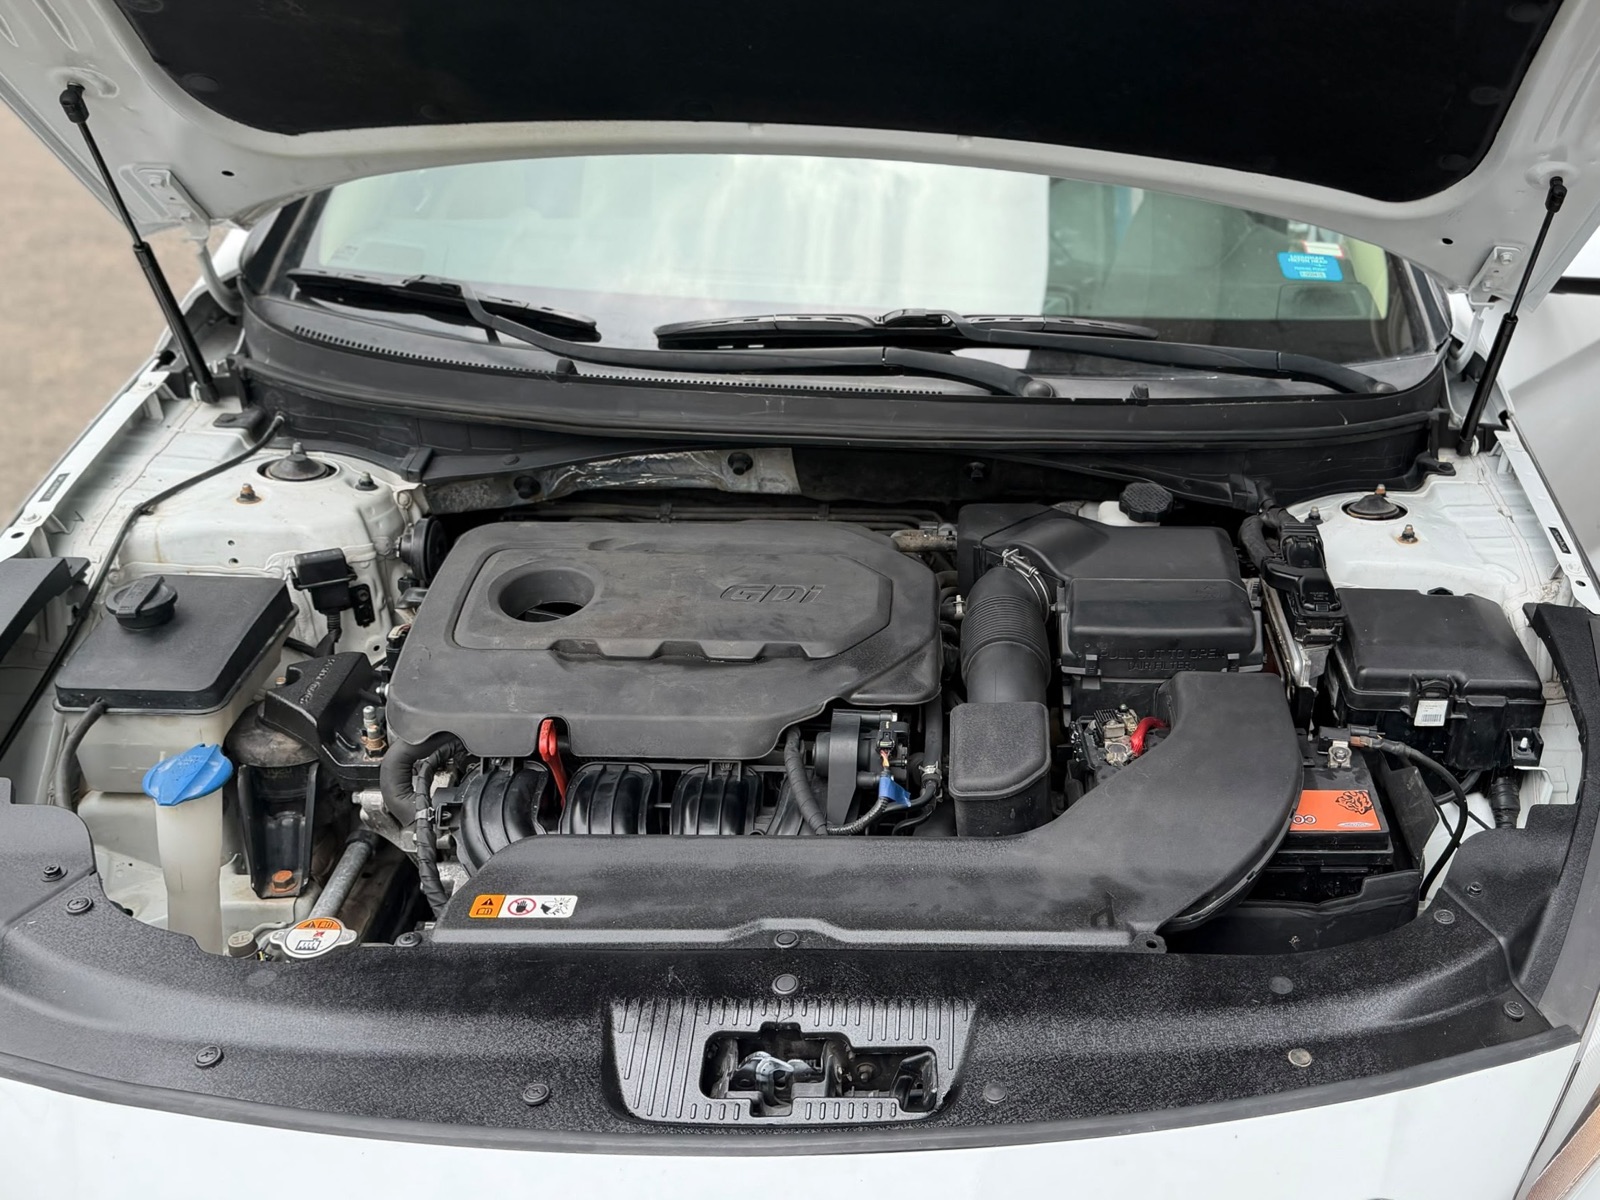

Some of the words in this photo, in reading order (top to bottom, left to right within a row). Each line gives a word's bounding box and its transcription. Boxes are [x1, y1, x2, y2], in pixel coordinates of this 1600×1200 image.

[1100, 649, 1134, 660] PULL
[1138, 649, 1165, 660] OUT
[1168, 649, 1186, 660] TO
